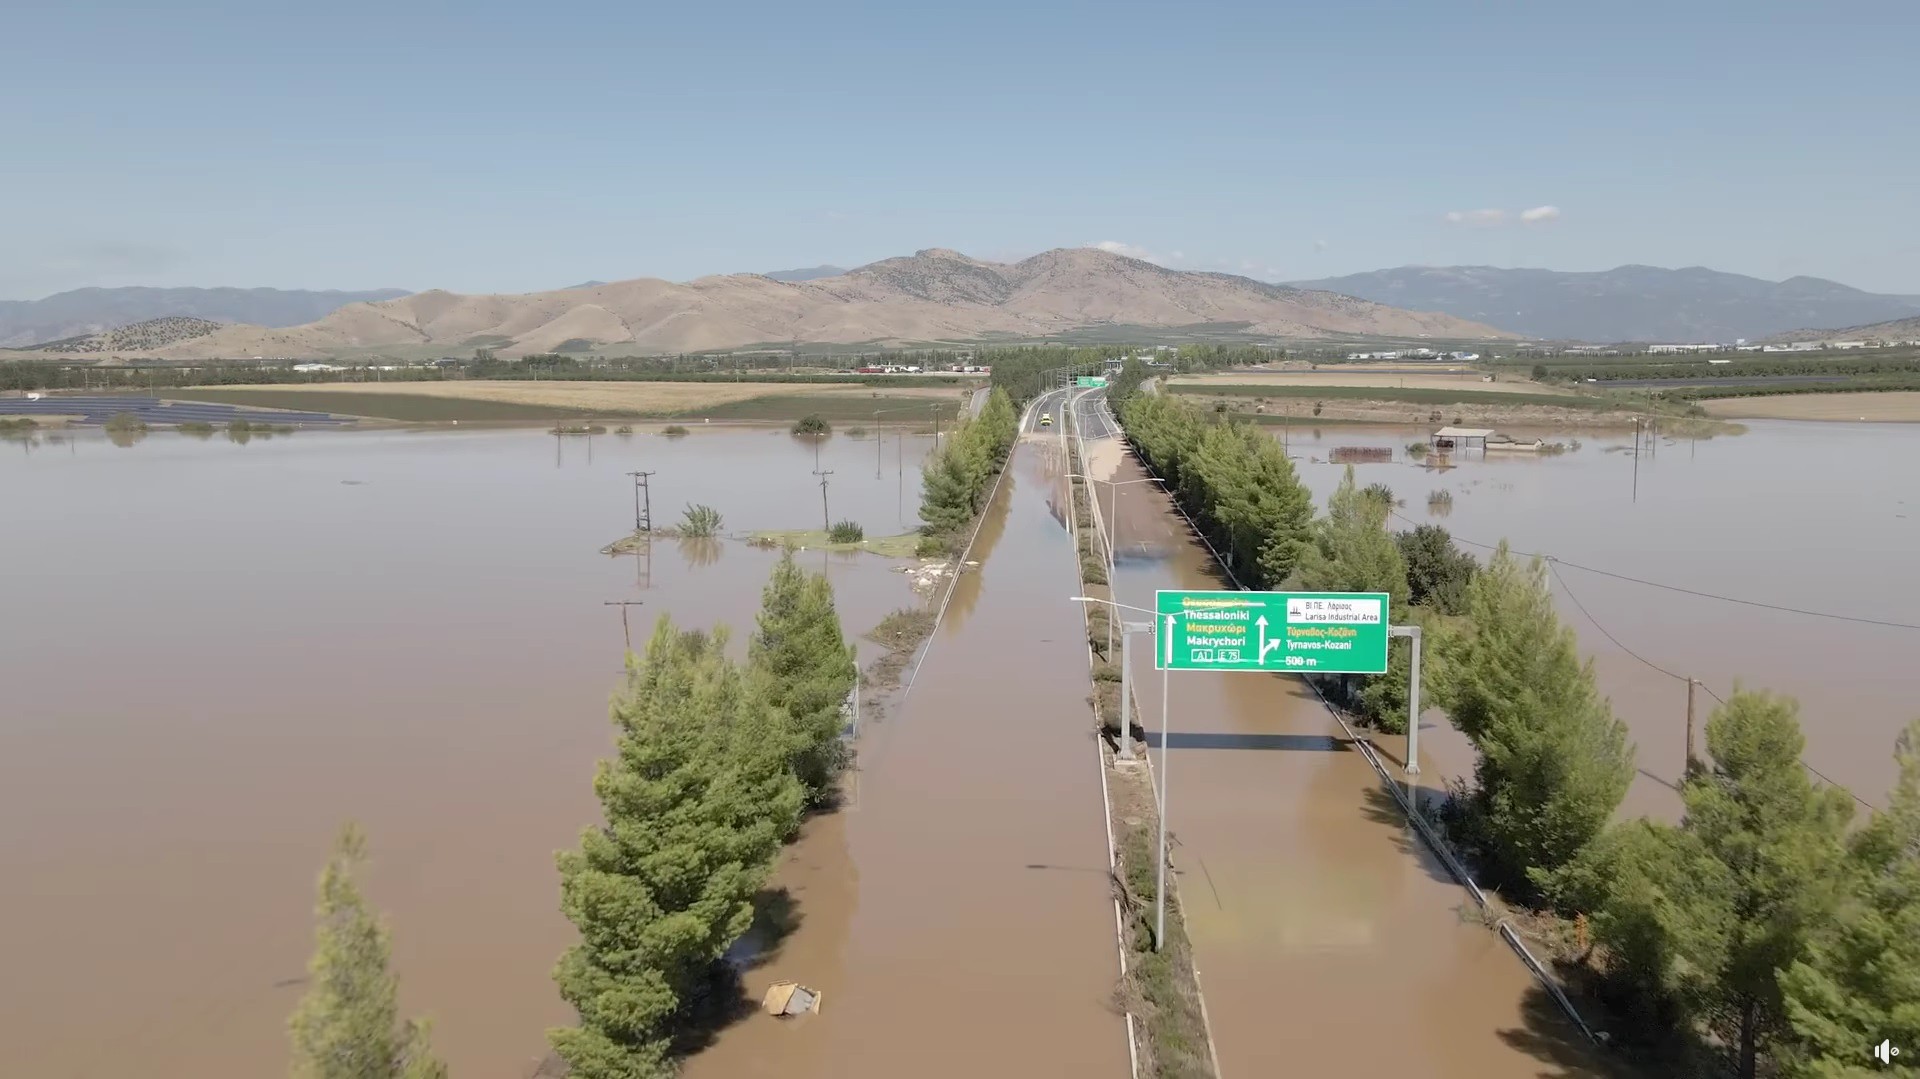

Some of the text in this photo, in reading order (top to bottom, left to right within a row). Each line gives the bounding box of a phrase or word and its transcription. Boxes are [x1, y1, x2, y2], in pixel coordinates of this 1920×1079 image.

[1184, 610, 1249, 620] Thessaloniki
[1305, 613, 1326, 621] Larisa
[1328, 613, 1360, 621] Industrial
[1187, 636, 1245, 648] Makrychori
[1306, 658, 1316, 666] m
